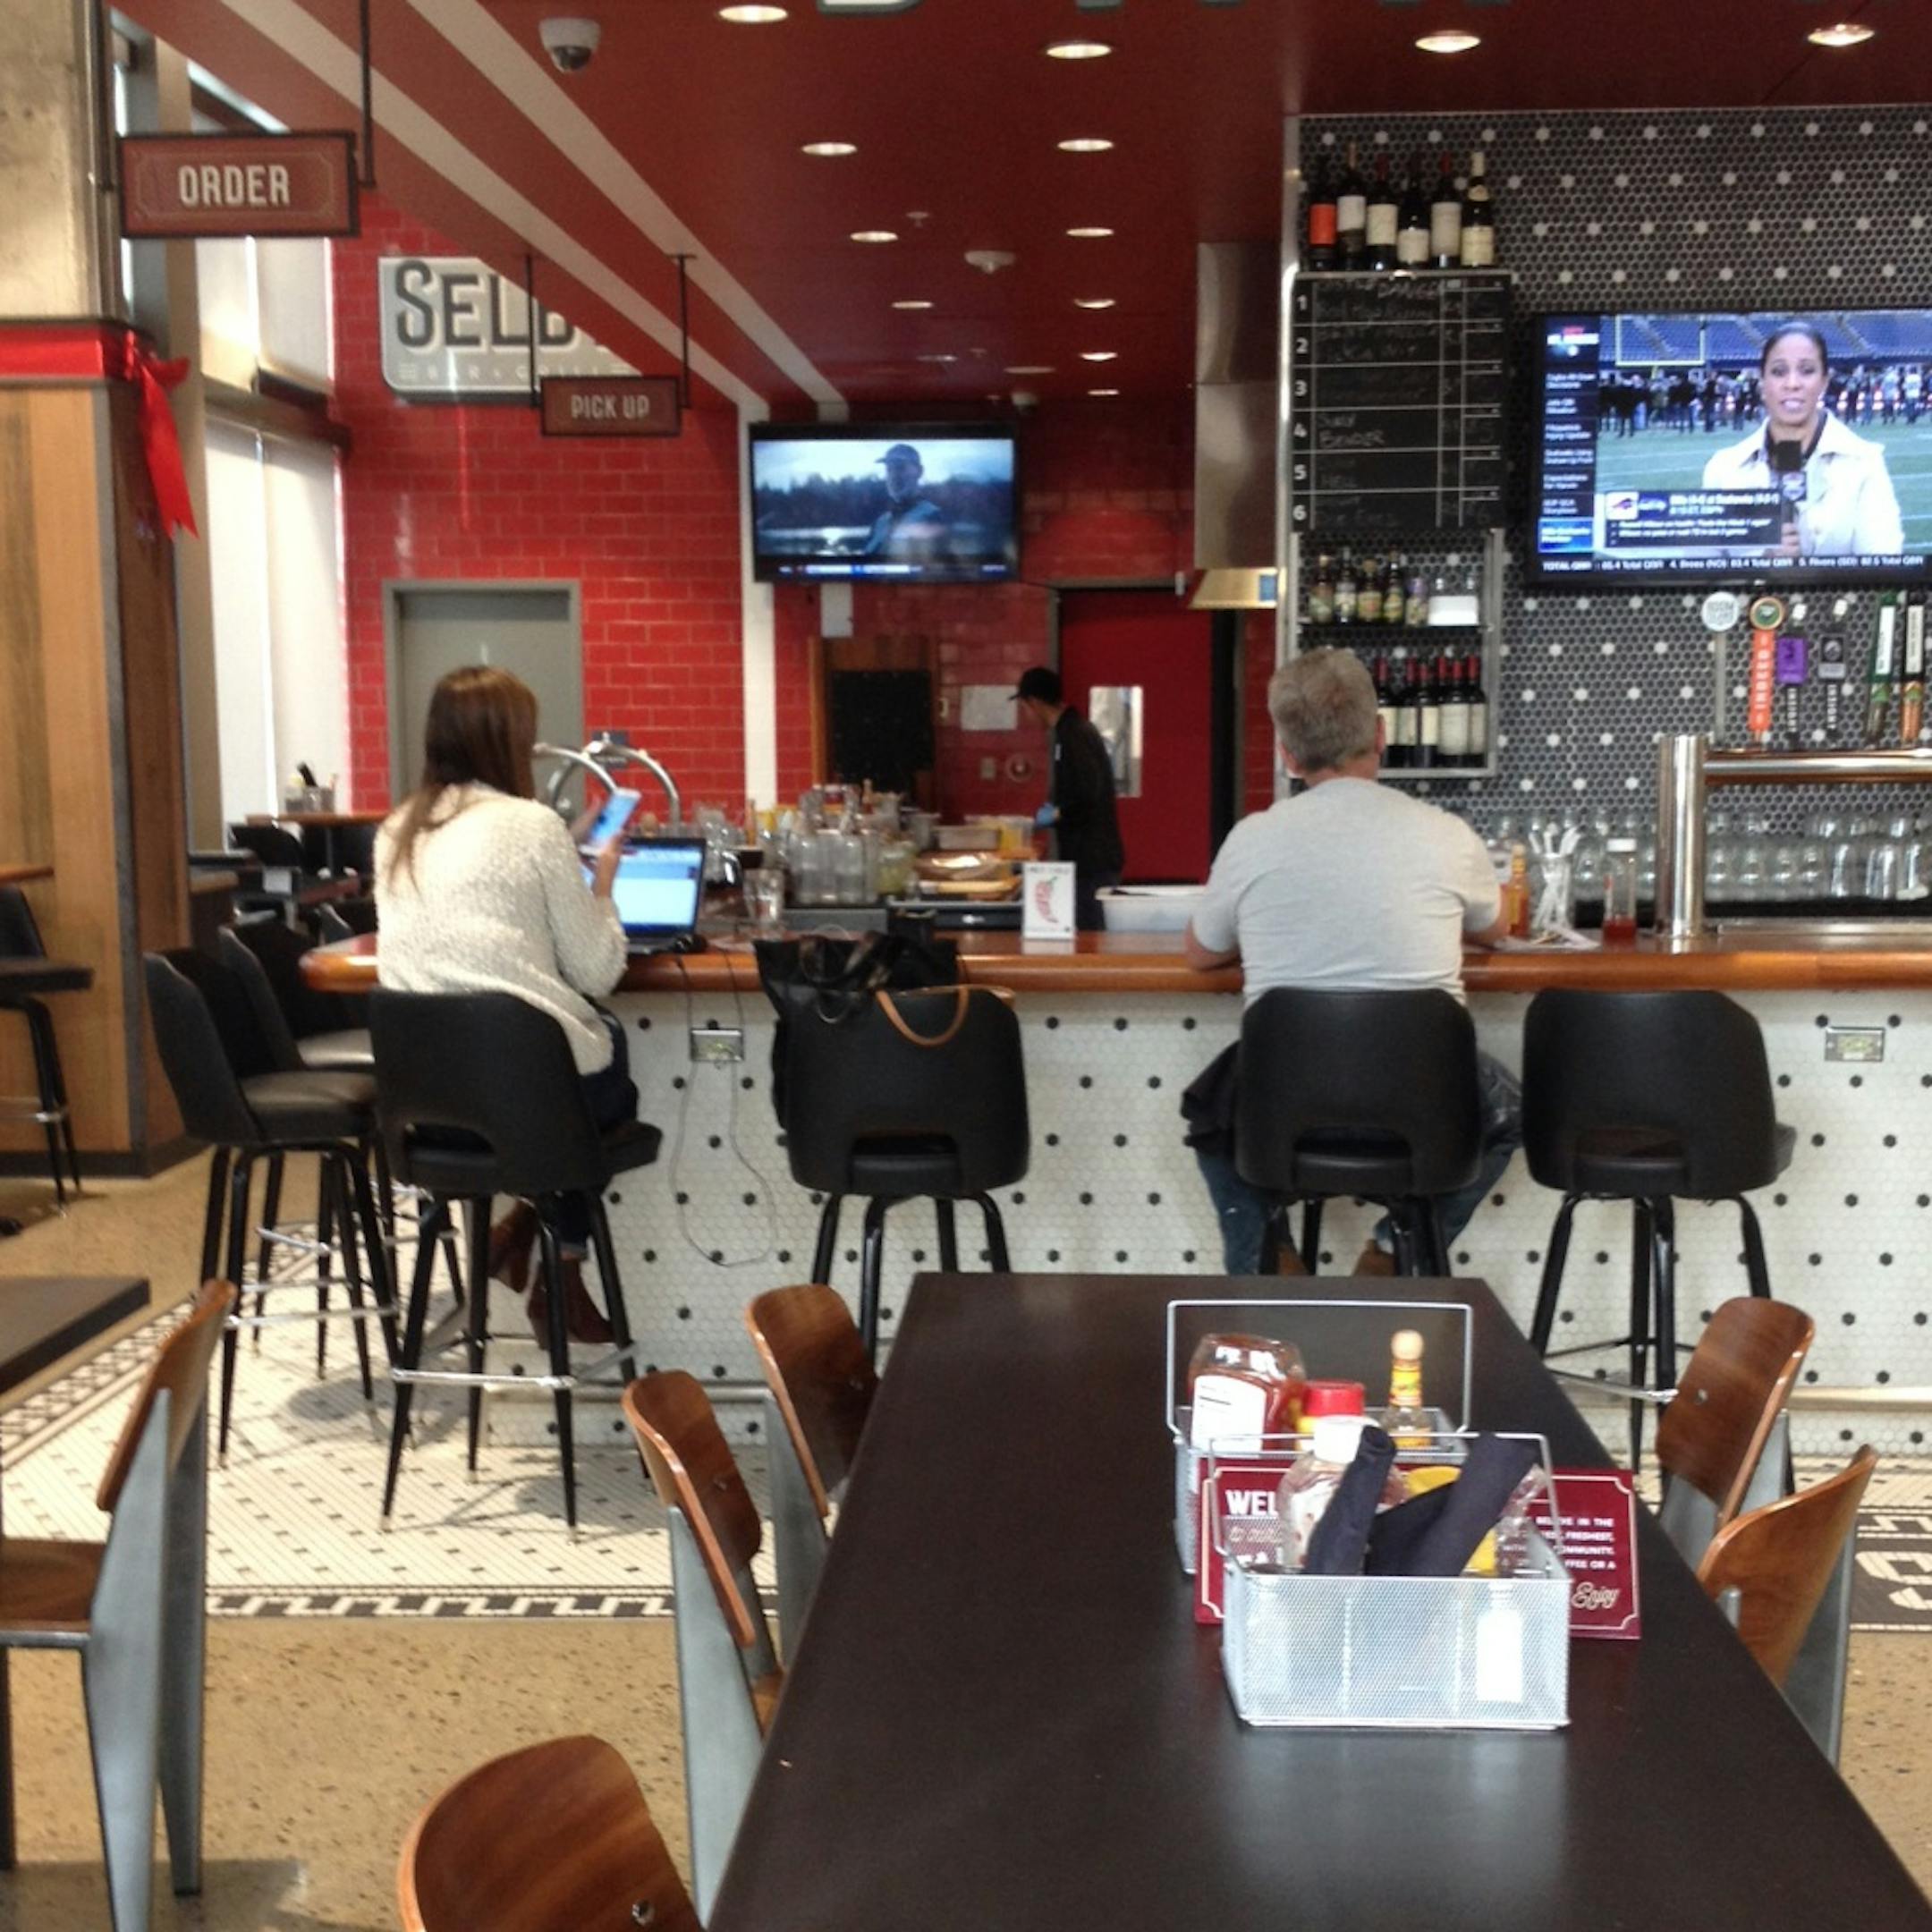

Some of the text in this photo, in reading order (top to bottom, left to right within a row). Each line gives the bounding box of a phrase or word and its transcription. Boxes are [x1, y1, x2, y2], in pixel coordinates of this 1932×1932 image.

[179, 165, 290, 208] ORDER
[394, 258, 577, 347] SELB
[1296, 294, 1308, 310] 1
[1296, 339, 1309, 354] 2
[1294, 381, 1308, 397] 3
[571, 394, 650, 419] PICK UP
[1293, 422, 1308, 438] 4
[1293, 464, 1308, 480] 5
[1292, 504, 1307, 521] 6
[1224, 1489, 1279, 1515] WEL
[1593, 1517, 1614, 1527] THE
[1572, 1581, 1620, 1610] Enjoy
